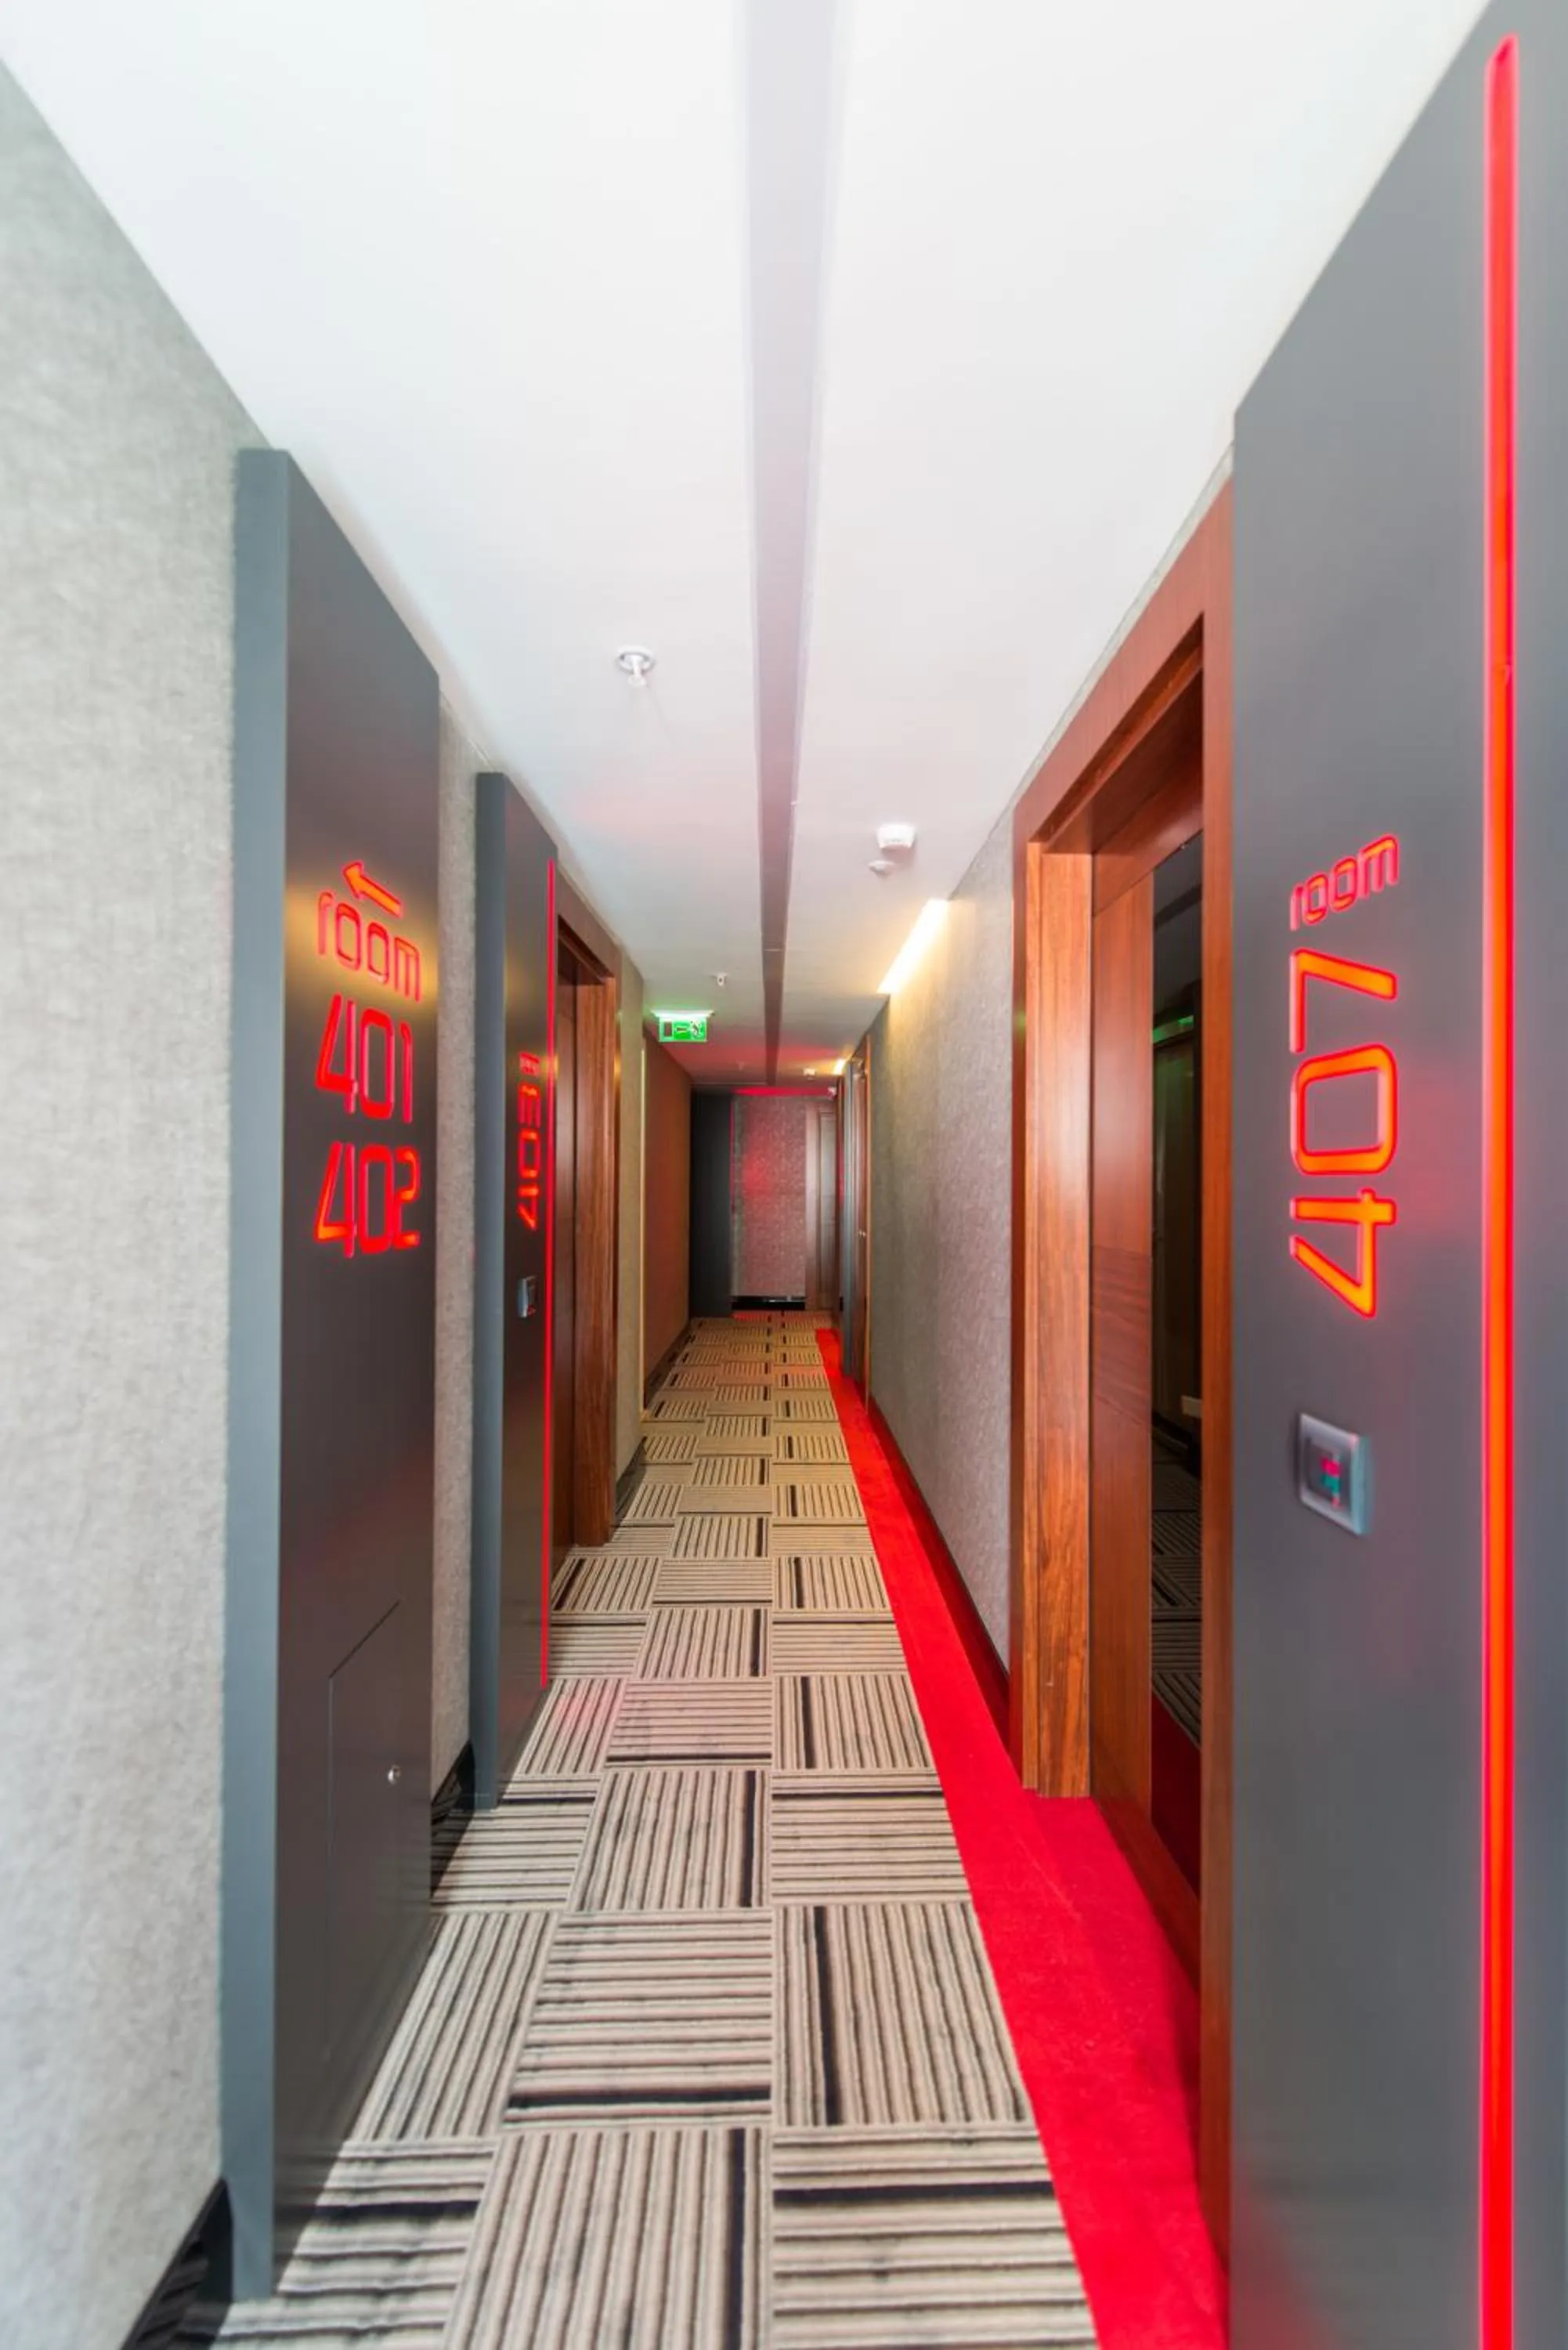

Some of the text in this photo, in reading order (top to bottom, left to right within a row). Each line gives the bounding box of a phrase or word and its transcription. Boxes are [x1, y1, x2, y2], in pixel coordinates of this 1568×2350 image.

[1289, 833, 1399, 931] room
[317, 891, 421, 1002] room
[315, 993, 413, 1124] 401
[518, 1083, 542, 1230] 403
[1289, 948, 1397, 1318] 407
[315, 1141, 421, 1258] 402
